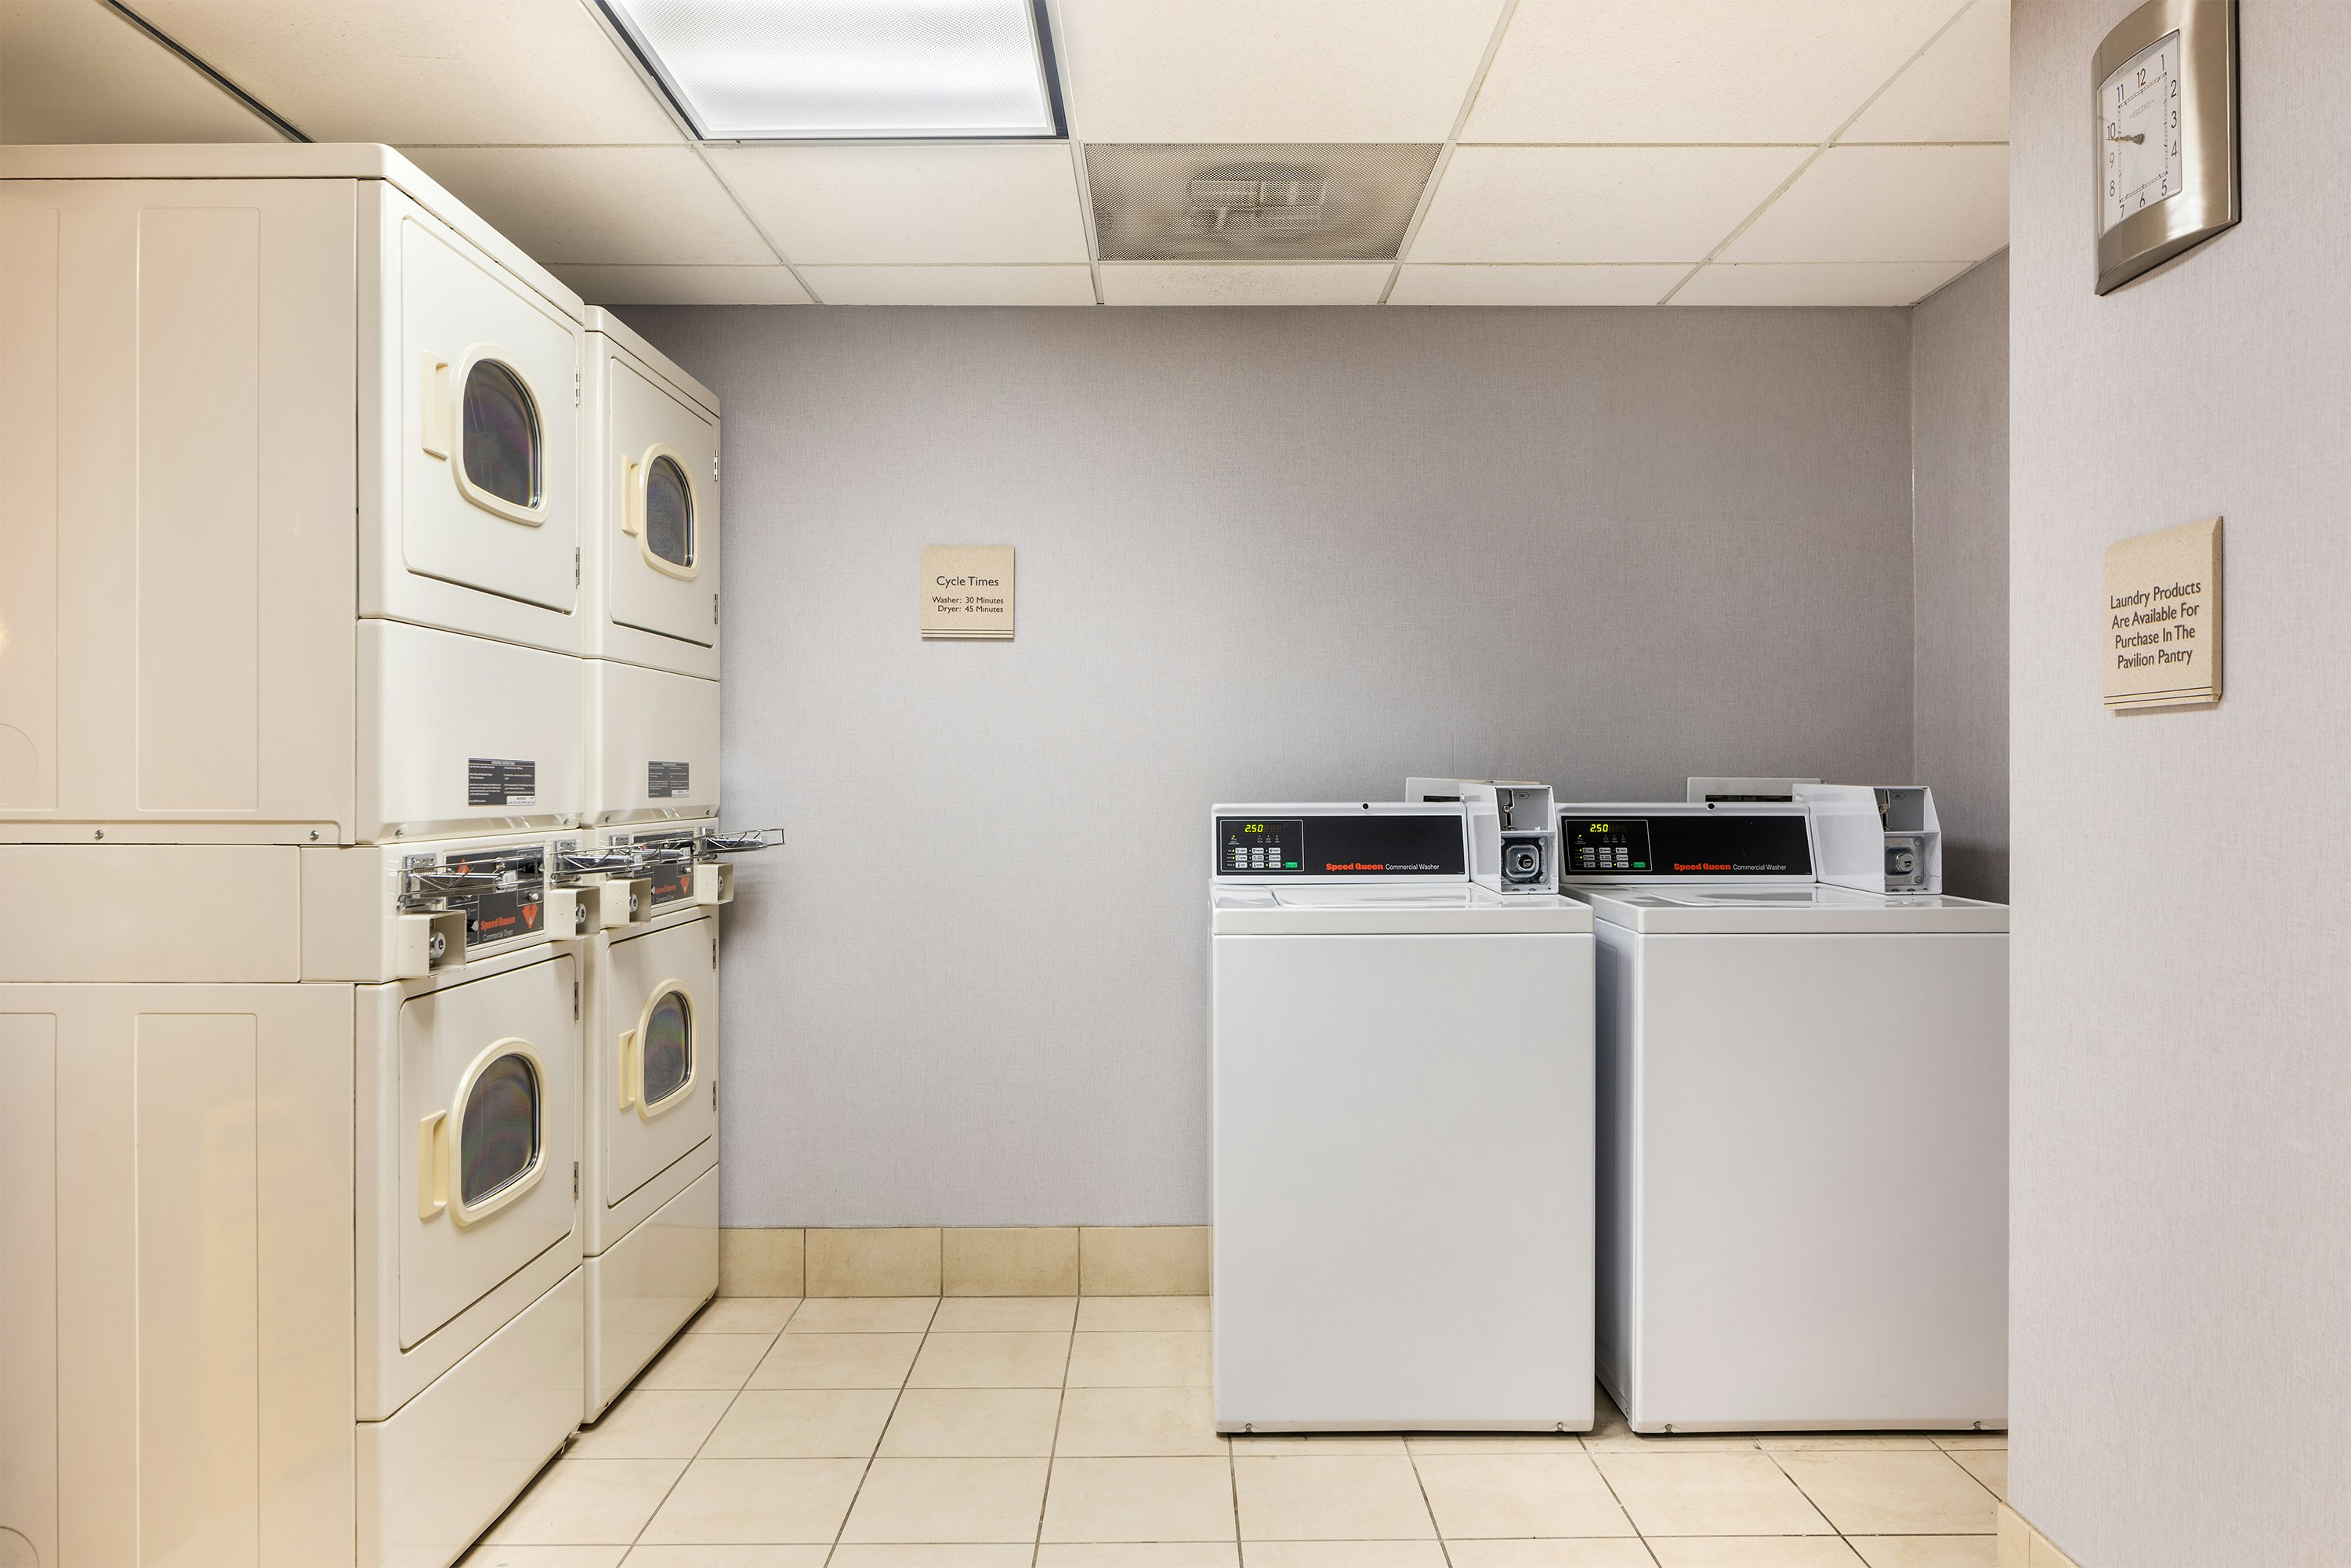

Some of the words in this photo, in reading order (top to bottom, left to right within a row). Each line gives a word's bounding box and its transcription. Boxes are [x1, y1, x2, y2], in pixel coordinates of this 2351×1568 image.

[2161, 53, 2165, 71] 1
[2136, 67, 2146, 89] 12
[2117, 83, 2125, 103] 11
[2170, 79, 2178, 97] 2
[2170, 110, 2178, 129] 3
[2106, 121, 2116, 139] 10
[2170, 140, 2178, 158] 4
[2109, 152, 2115, 169] 9
[2109, 179, 2115, 197] 8
[2161, 179, 2168, 196] 5
[2139, 192, 2146, 208] 6
[2119, 205, 2125, 219] 7
[936, 575, 965, 588] Cycle
[967, 576, 999, 586] Times
[2110, 590, 2150, 609] Laundry
[2154, 582, 2201, 601] Products
[937, 605, 962, 614] Dryer:
[2111, 614, 2130, 629] Are
[2132, 605, 2177, 626] Available
[2180, 602, 2200, 617] For
[2115, 632, 2159, 649] Purchase
[2163, 627, 2172, 642] In
[2174, 625, 2195, 640] The
[2117, 653, 2154, 669] Pavilion
[2158, 649, 2193, 665] Pantry
[1244, 824, 1264, 833] 2.50
[1589, 824, 1609, 832] 2.50
[1325, 863, 1354, 871] Speed
[1673, 863, 1701, 871] Speed
[480, 918, 498, 931] Speed
[498, 916, 516, 926] Queen
[483, 930, 503, 941] Commercial
[503, 929, 514, 938] Dryer
